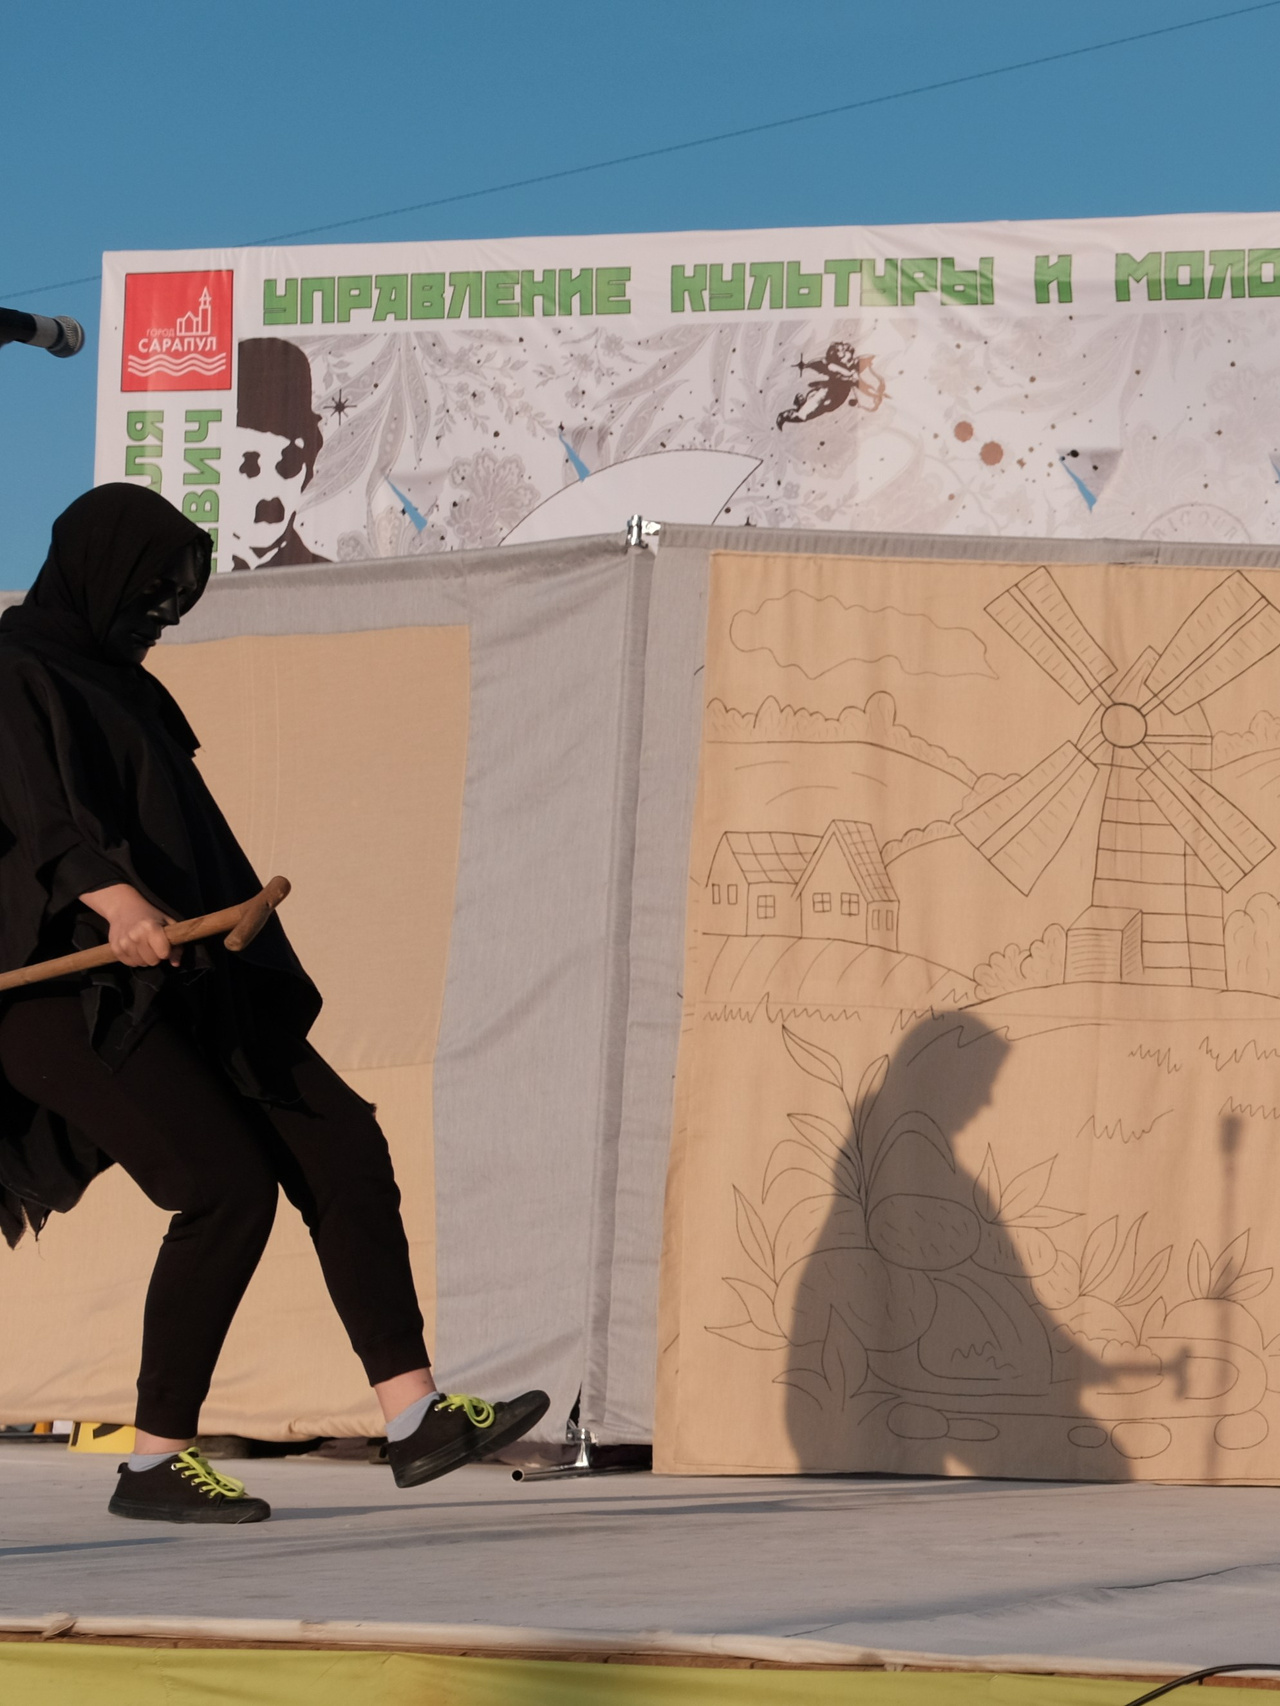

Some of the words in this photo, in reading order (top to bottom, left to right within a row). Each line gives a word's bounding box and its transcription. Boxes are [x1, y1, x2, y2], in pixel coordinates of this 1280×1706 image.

[263, 266, 631, 326] УПРАВЛЕНИЕ
[670, 256, 995, 313] КУЛЬТУРЫ
[1034, 253, 1073, 304] И
[138, 336, 217, 353] САРАПУЛ
[147, 328, 175, 337] ГОРОД
[125, 410, 164, 495] ЛЯ
[182, 409, 223, 574] ВИЧ
